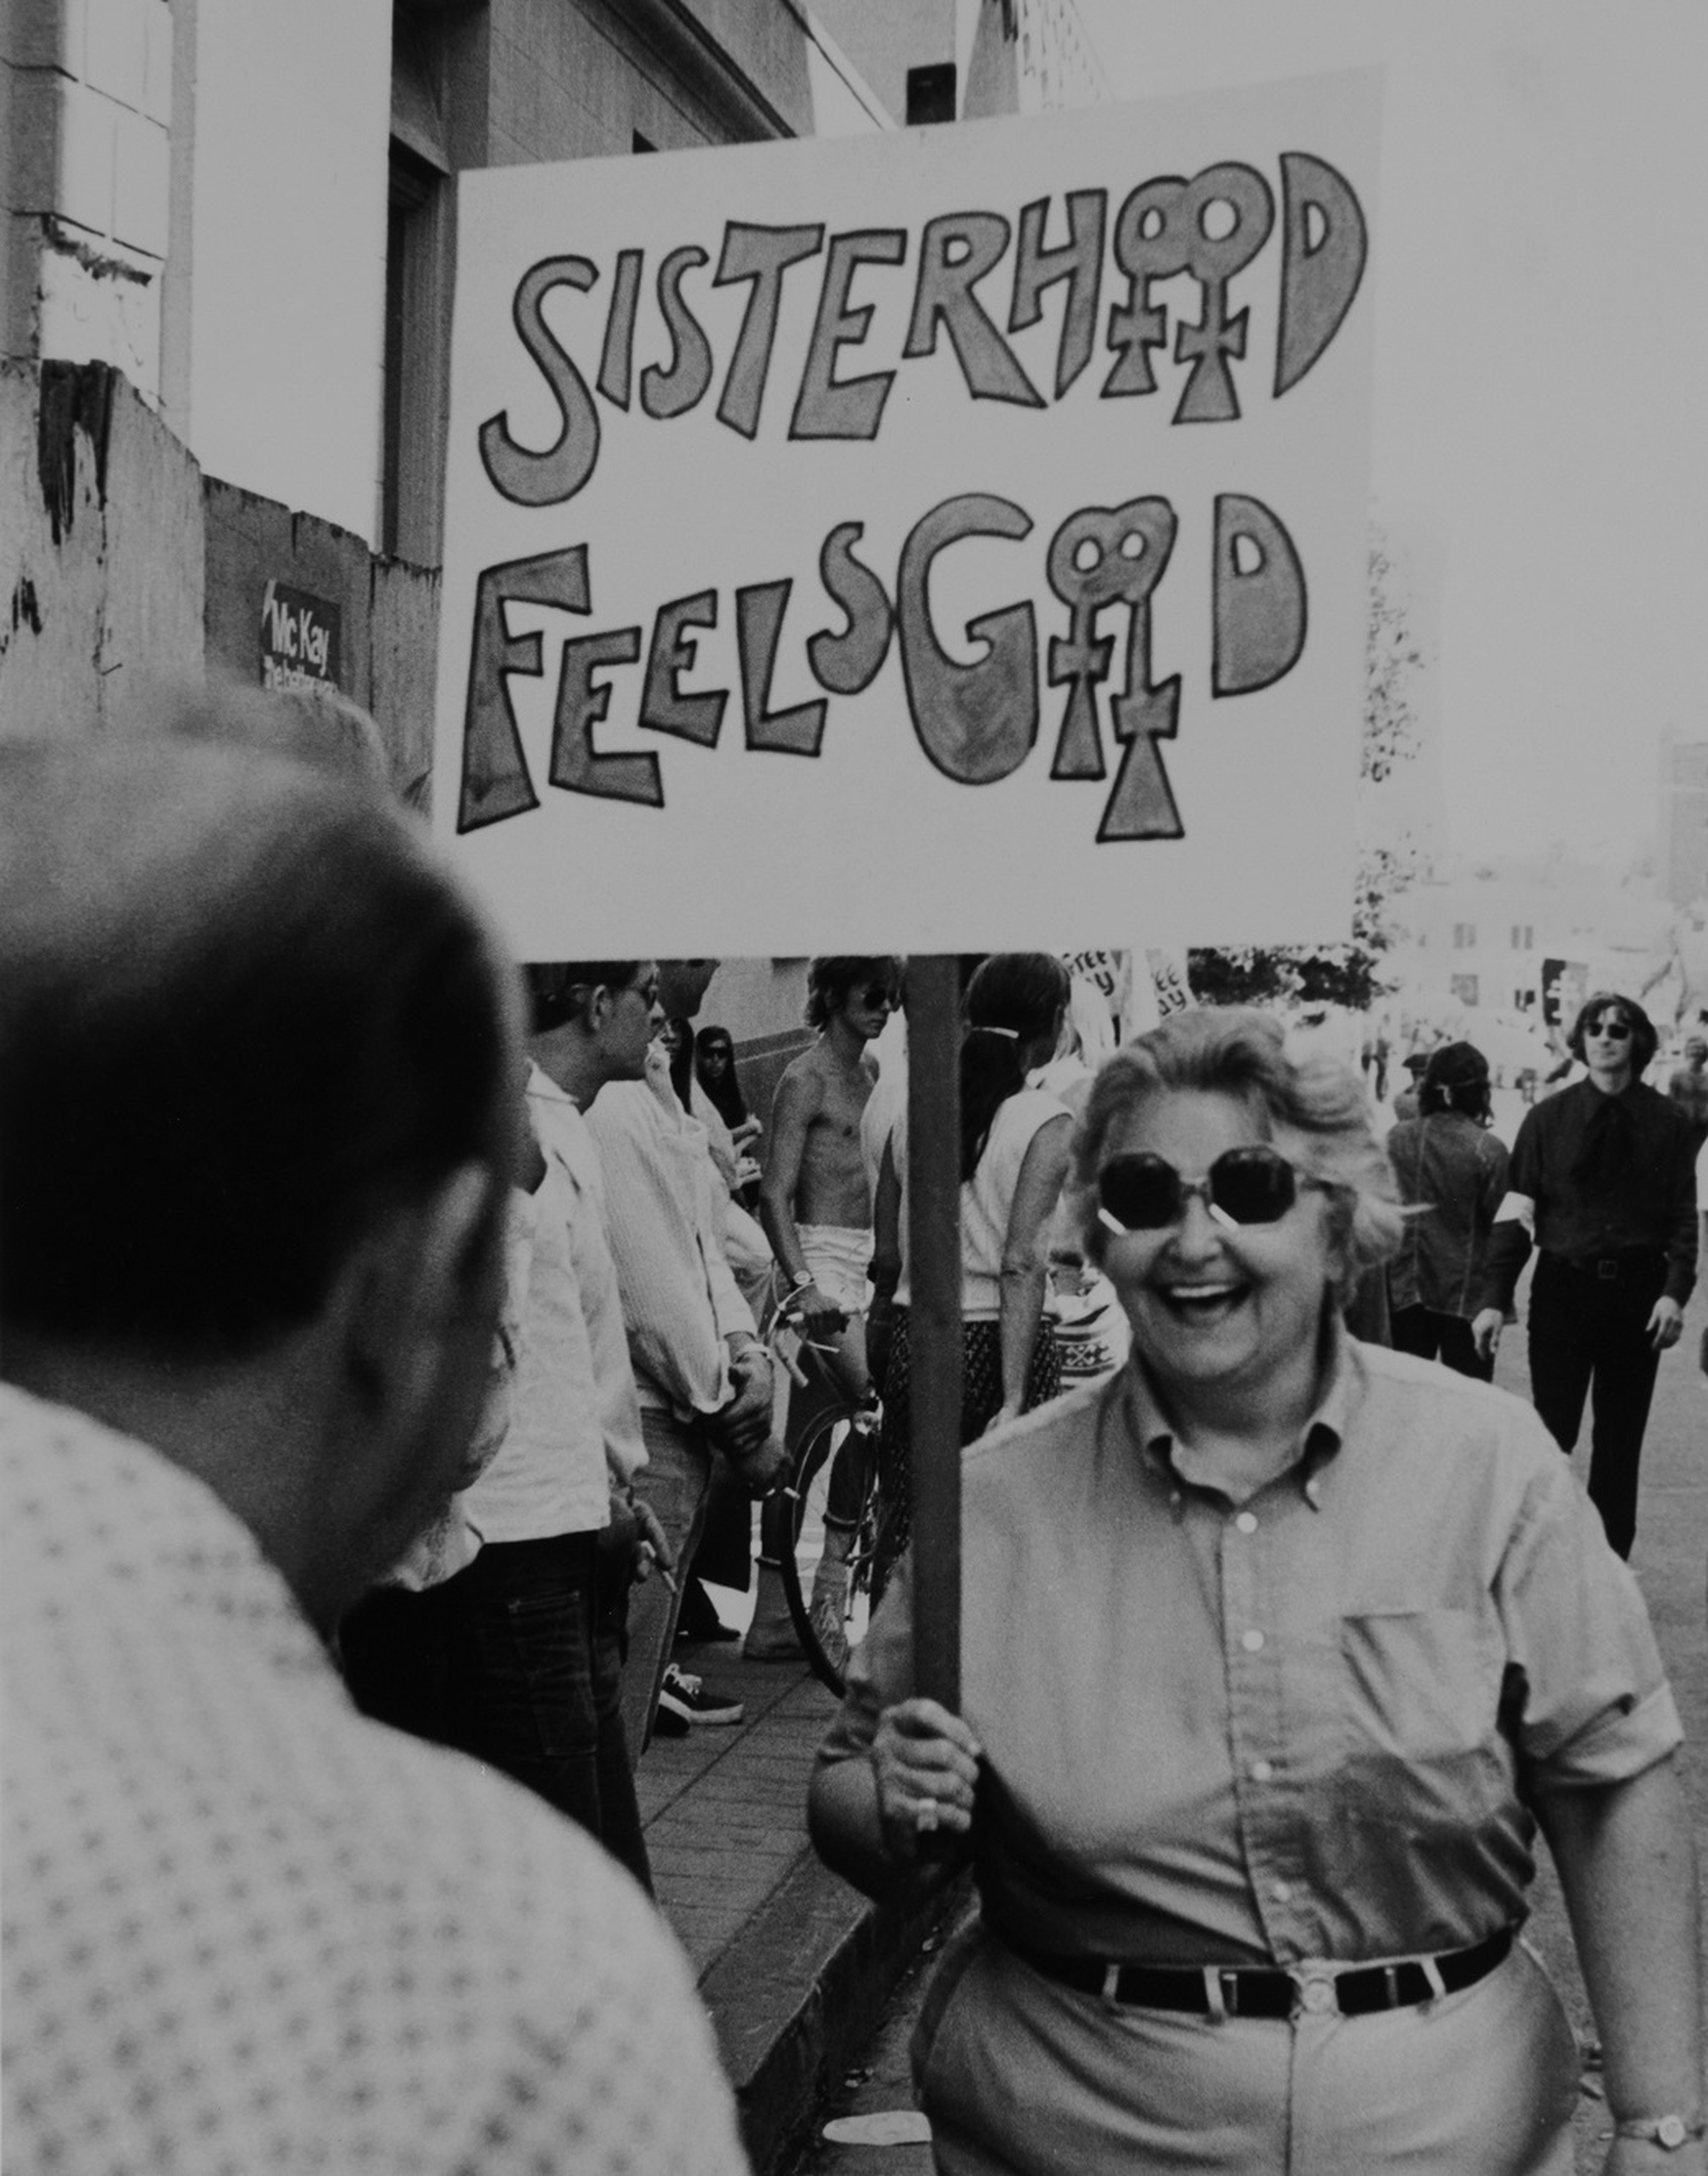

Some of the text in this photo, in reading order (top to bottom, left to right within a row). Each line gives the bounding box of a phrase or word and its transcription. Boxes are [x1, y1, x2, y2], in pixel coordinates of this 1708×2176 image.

[478, 151, 1368, 507] SISTERHOOD
[456, 492, 1309, 842] FEELS GOOD
